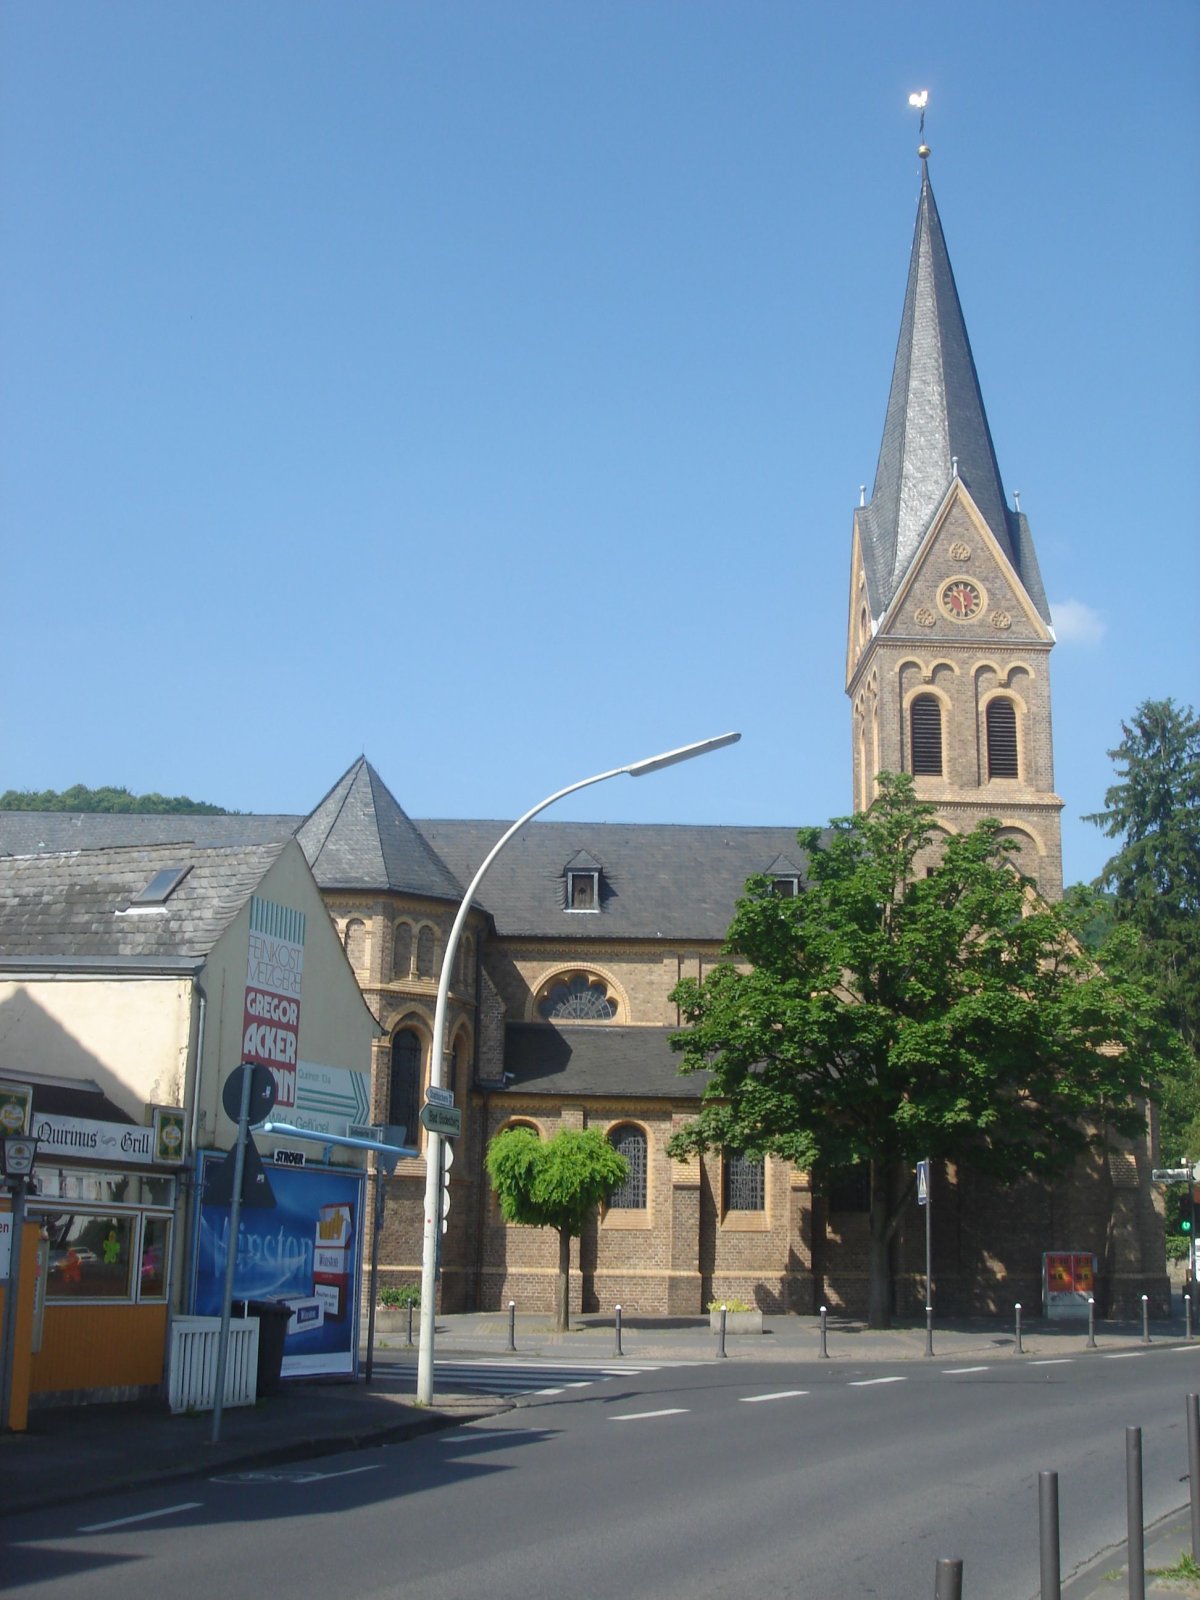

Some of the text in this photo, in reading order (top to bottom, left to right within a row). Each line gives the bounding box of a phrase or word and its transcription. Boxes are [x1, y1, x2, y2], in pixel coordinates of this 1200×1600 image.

[246, 992, 298, 1027] GREGOR
[243, 1023, 297, 1065] ACKER
[37, 1121, 150, 1155] Quirinus Grill
[275, 1151, 304, 1165] STRÖER
